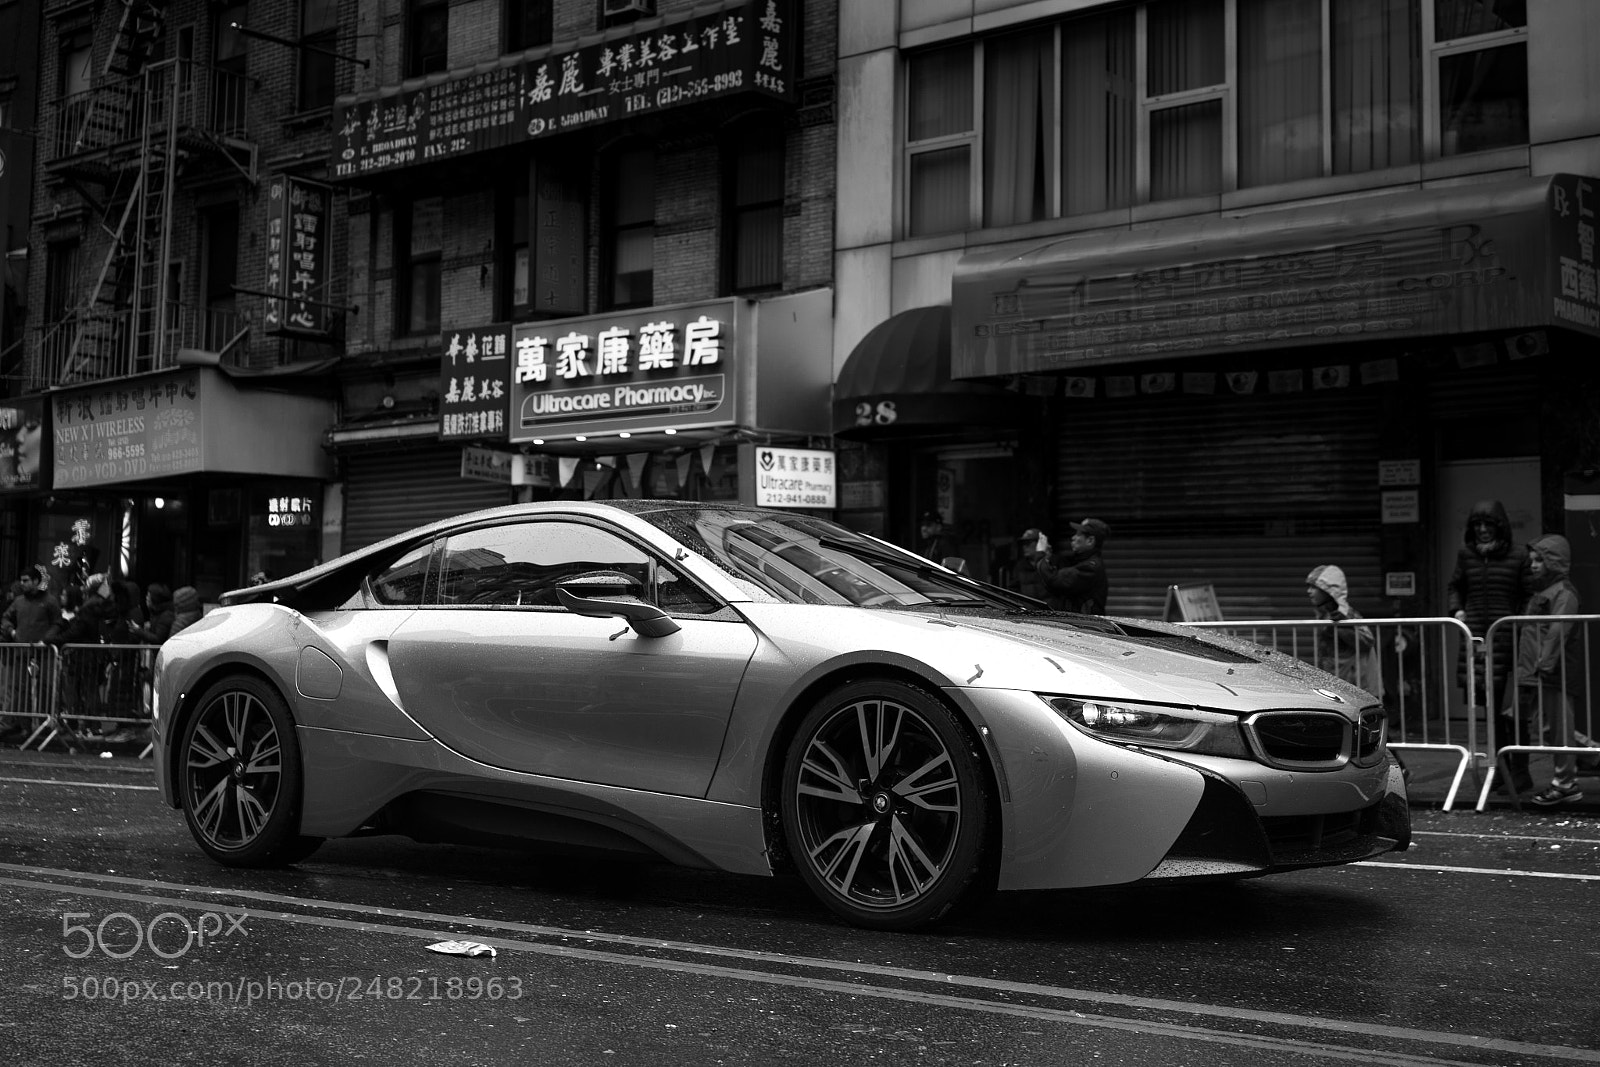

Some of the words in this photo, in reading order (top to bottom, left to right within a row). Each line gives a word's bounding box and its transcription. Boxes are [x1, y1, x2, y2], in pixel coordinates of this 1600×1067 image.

[528, 52, 584, 105] 嘉麗
[336, 163, 356, 176] TEL:
[1560, 255, 1600, 307] 西藥
[975, 319, 1045, 337] BEST
[1071, 304, 1156, 328] CARE
[1175, 280, 1375, 316] PHARMACY
[1397, 267, 1517, 292] CORP.
[1553, 297, 1600, 329] PHARMACY
[516, 316, 719, 384] 萬家康藥房
[1043, 349, 1111, 362] TEL:
[1128, 338, 1204, 355] (212)
[533, 393, 611, 413] Ultracare
[614, 384, 704, 406] Pharmacy
[855, 401, 897, 427] 28
[56, 426, 80, 444] NEW
[95, 416, 144, 438] WIRELESS
[107, 443, 145, 460] 966-5595
[72, 465, 87, 482] CD
[94, 461, 117, 480] VCD
[124, 458, 147, 476] DVD
[761, 474, 803, 491] Ultracare
[767, 493, 827, 504] 212-941-0888
